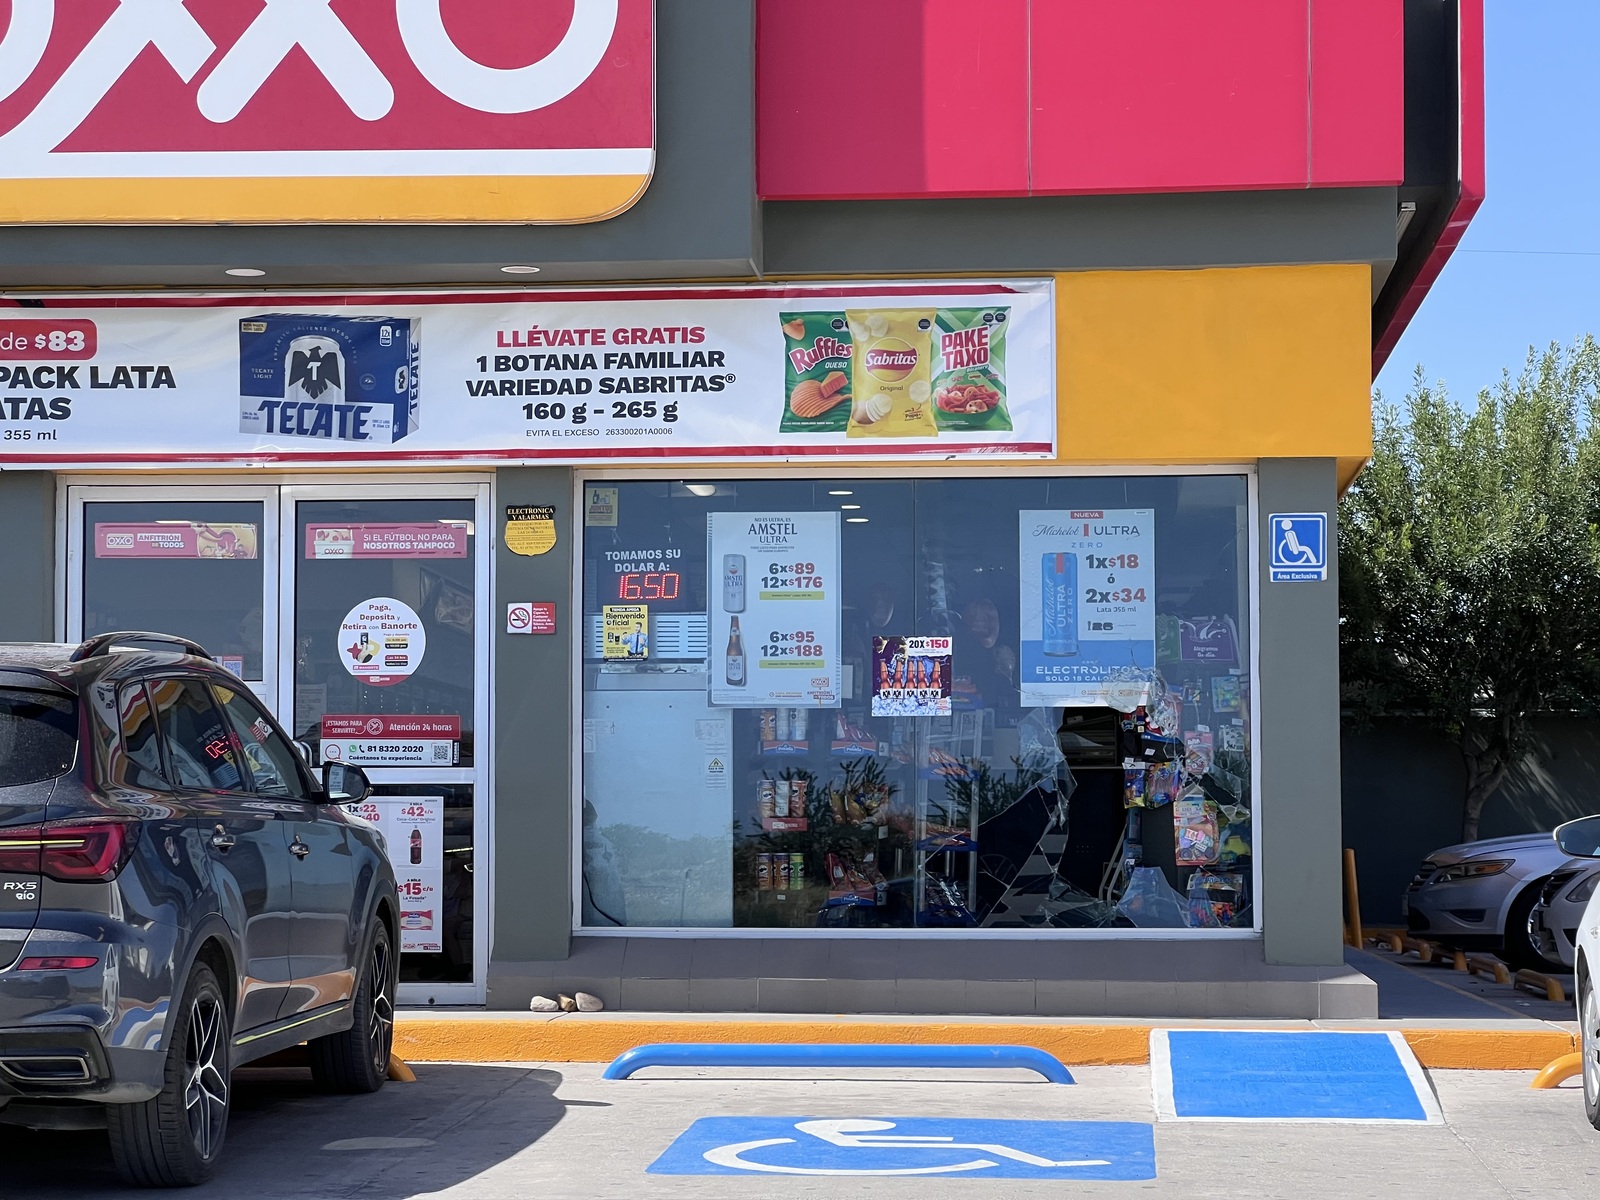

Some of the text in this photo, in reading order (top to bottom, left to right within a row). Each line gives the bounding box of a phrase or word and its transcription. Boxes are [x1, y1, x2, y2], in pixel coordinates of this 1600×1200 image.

[34, 330, 86, 352] $83
[496, 324, 706, 347] LLÉVATE GRATIS
[942, 326, 989, 352] PAKE
[476, 350, 725, 372] 1 BOTANA FAMILIAR
[788, 336, 852, 375] Ruffles
[865, 353, 917, 367] Sabritas
[942, 347, 989, 370] TAXO
[90, 365, 177, 389] LATA
[408, 341, 420, 416] TECATE
[465, 378, 593, 397] VARIEDAD
[0, 397, 72, 421] TAS
[522, 403, 566, 420] 160
[571, 403, 587, 424] g
[611, 401, 657, 419] 265
[662, 401, 678, 422] g
[258, 400, 374, 440] TECATE
[3, 429, 57, 441] 355 ml
[526, 429, 550, 437] EVITA
[552, 429, 563, 437] EL
[565, 428, 600, 437] EXCESO
[748, 523, 798, 535] AMSTEL
[1032, 525, 1141, 537] Michelob ULTRA
[107, 537, 133, 545] OXXO
[384, 532, 416, 541] FÚTBOL
[413, 541, 455, 549] TAMPOCO
[605, 549, 681, 560] TOMAMOS SU
[614, 562, 670, 572] DOLAR A:
[1086, 554, 1139, 569] 1x$18
[769, 563, 815, 574] 6x$89
[761, 576, 823, 588] 12x$176
[1086, 588, 1146, 603] 2x$34
[369, 604, 391, 612] Paga,
[1057, 584, 1066, 627] ULTRA
[770, 631, 815, 643] 6x$95
[761, 645, 823, 657] 12x$188
[389, 723, 453, 731] Atención 24 horas
[3, 882, 37, 890] RX5
[397, 883, 422, 895] $15
